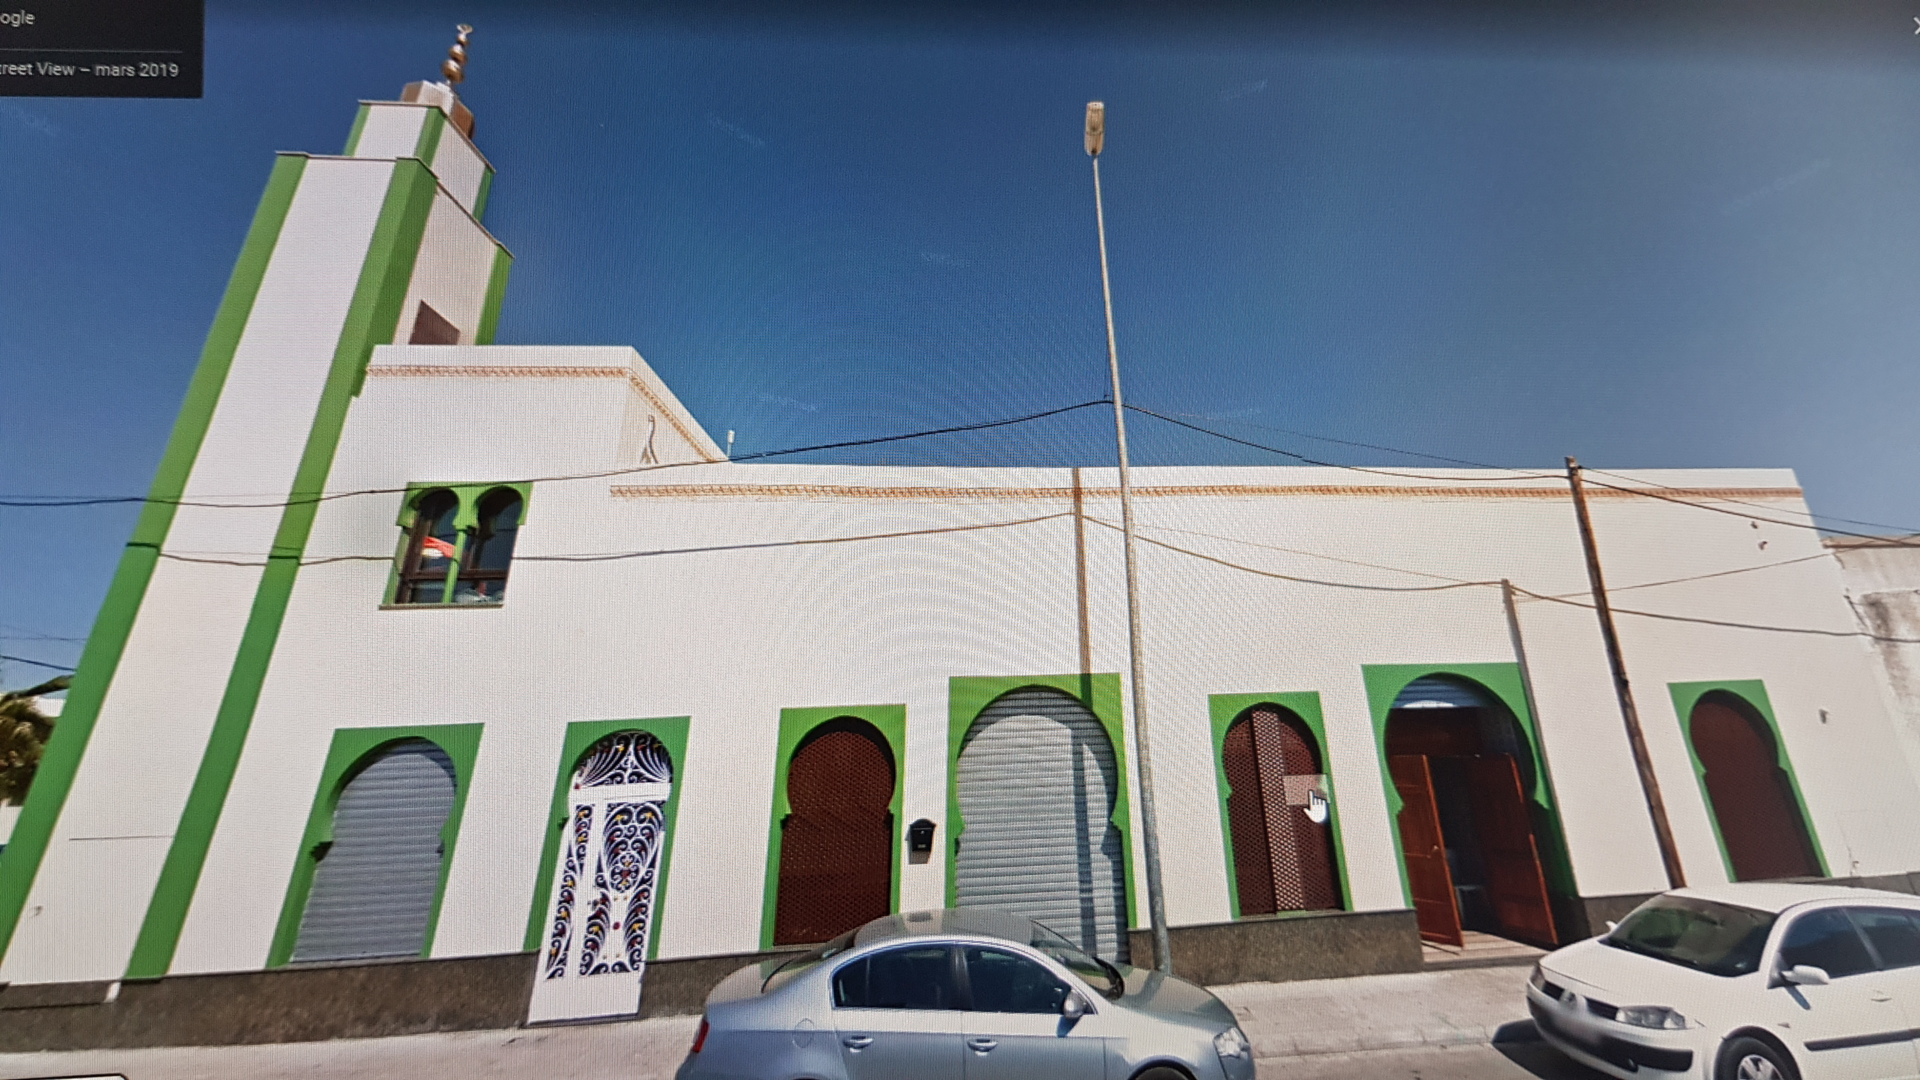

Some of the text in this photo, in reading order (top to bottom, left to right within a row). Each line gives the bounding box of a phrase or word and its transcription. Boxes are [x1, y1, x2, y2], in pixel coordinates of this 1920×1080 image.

[36, 62, 76, 76] View
[95, 64, 135, 77] mars
[138, 62, 180, 77] 2019
